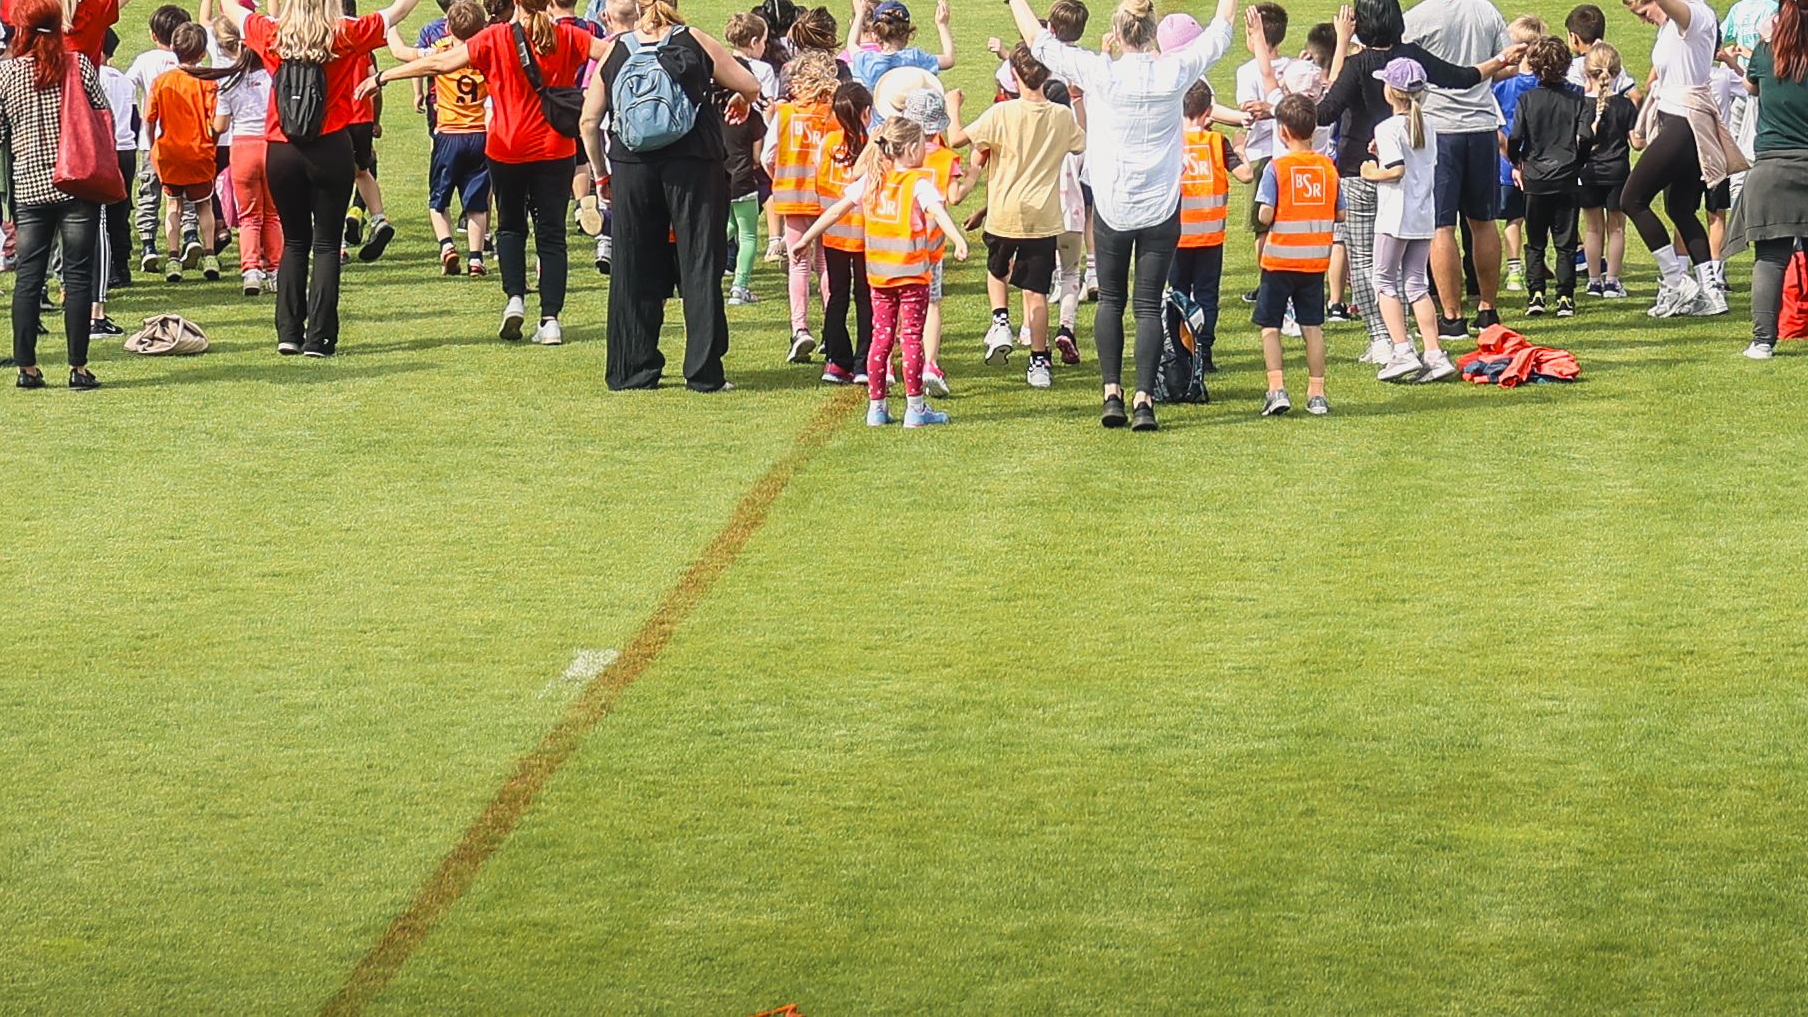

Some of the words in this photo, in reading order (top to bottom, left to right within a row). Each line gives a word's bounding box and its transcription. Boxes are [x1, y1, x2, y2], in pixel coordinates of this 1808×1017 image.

[456, 74, 479, 103] 9
[794, 120, 822, 144] BSR
[1294, 173, 1323, 199] BSR
[878, 190, 896, 215] SR
